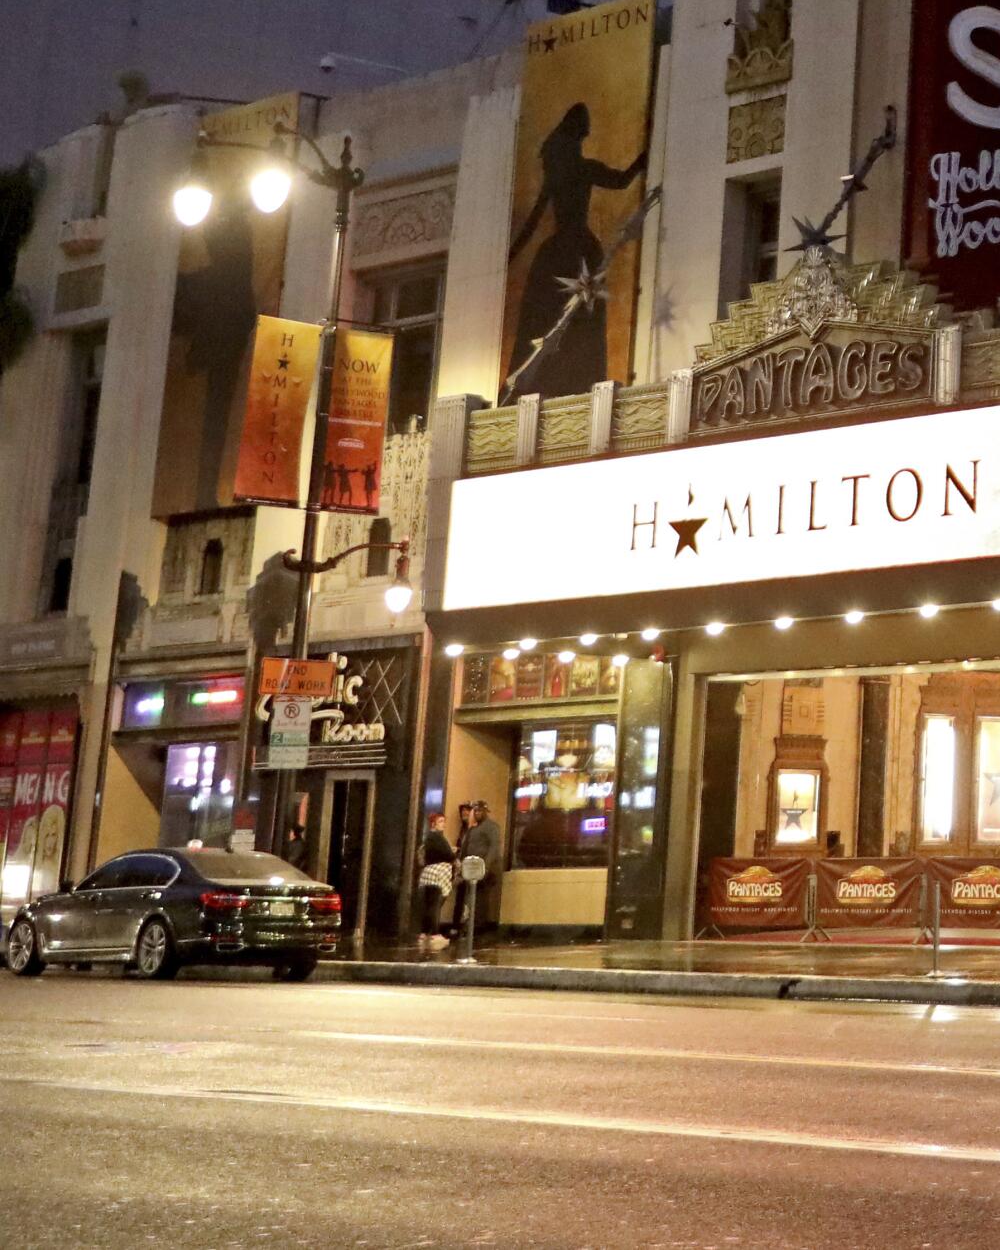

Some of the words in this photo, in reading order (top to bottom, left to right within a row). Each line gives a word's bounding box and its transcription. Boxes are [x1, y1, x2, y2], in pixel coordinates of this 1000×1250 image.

[341, 359, 381, 373] NOW
[700, 339, 925, 424] PANTAGES
[286, 664, 308, 676] END
[298, 679, 326, 691] WORK
[729, 881, 783, 897] PANTAGES
[838, 881, 897, 898] PANTAGES
